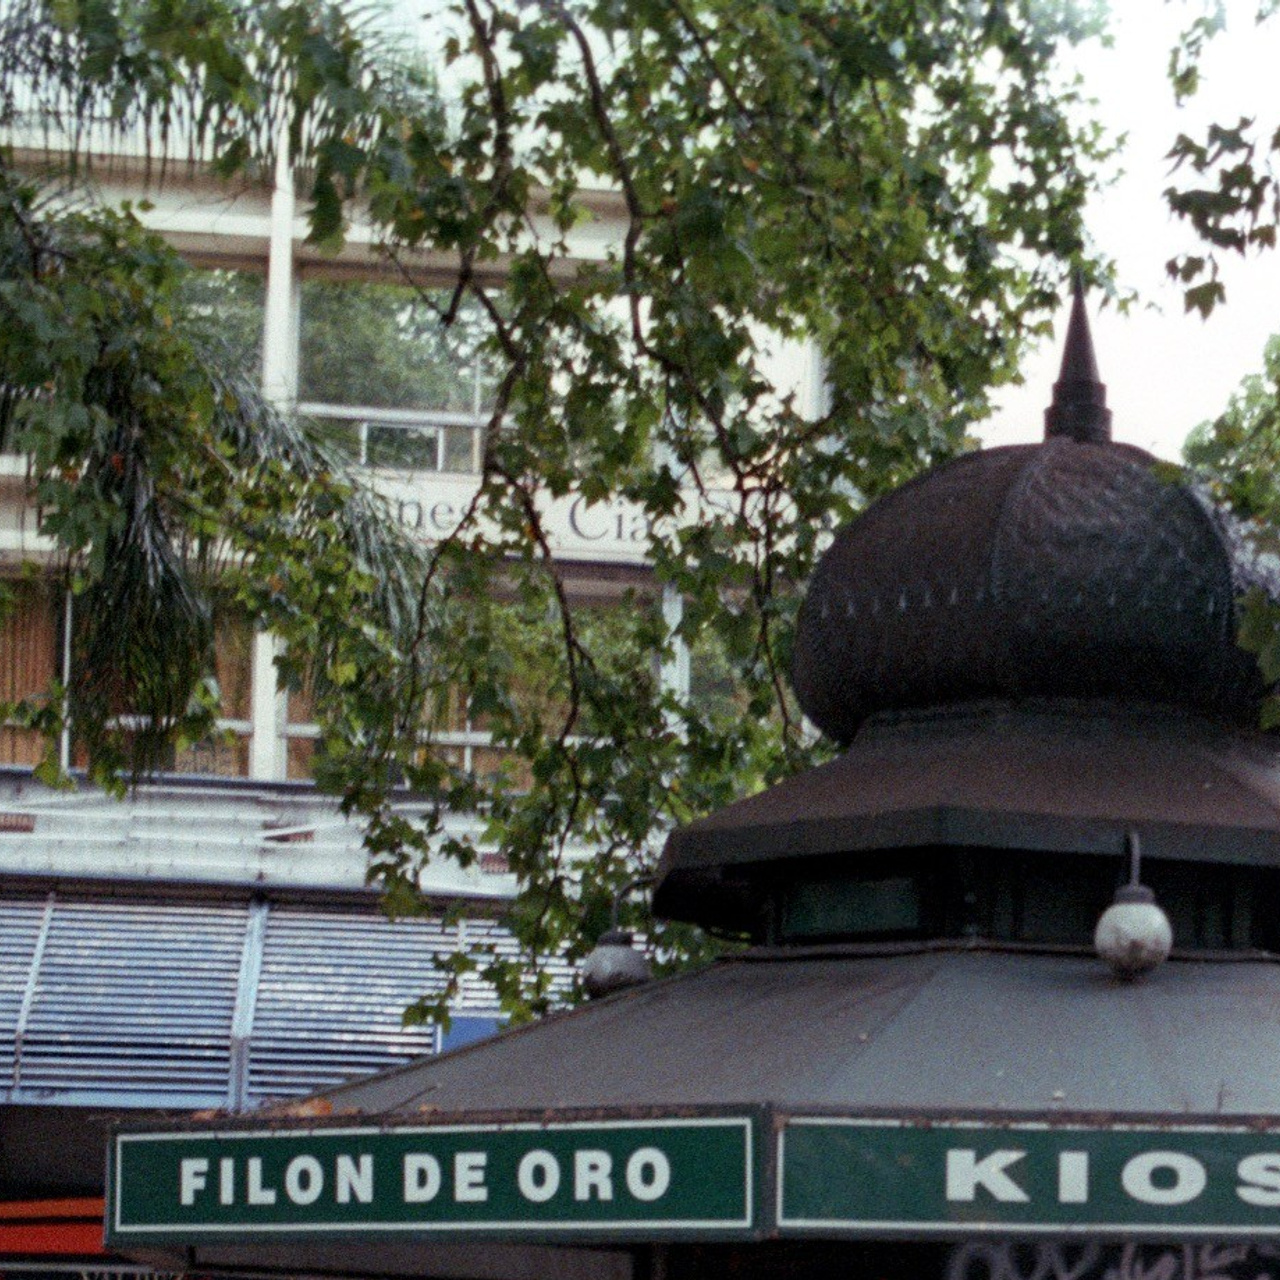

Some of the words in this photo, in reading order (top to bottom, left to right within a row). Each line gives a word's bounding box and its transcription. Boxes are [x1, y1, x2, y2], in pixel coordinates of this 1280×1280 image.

[181, 1153, 375, 1205] FILON
[404, 1151, 488, 1202] DE
[518, 1147, 671, 1202] ORO
